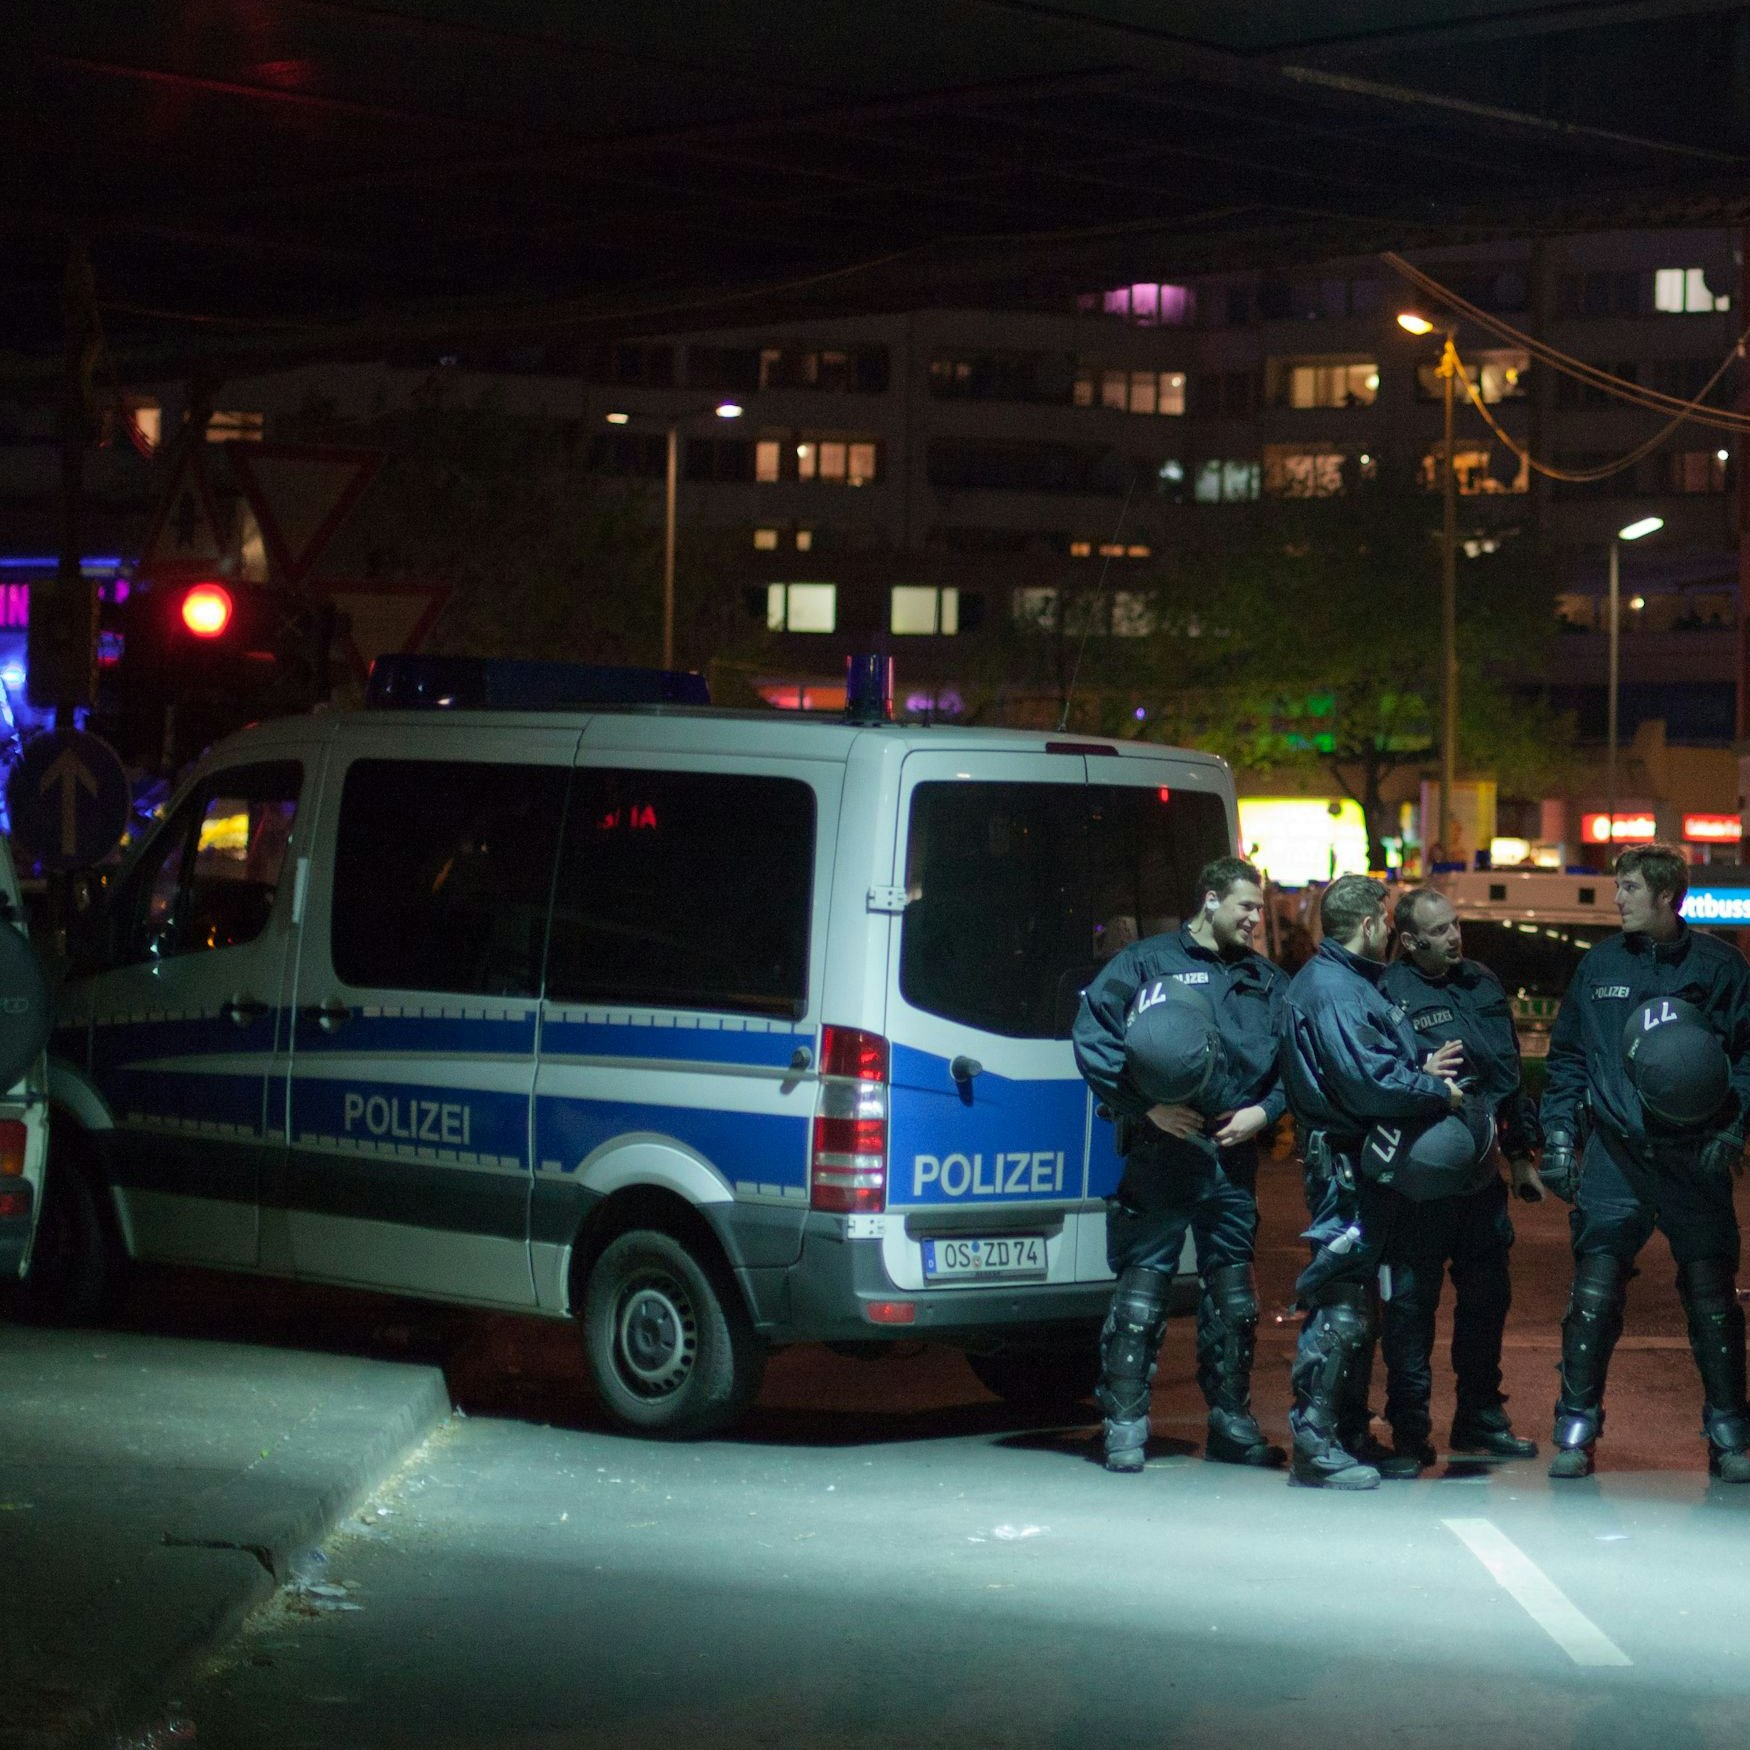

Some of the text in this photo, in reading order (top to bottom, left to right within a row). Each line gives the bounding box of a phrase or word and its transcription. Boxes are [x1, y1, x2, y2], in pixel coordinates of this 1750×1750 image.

[1412, 1008, 1453, 1031] POLIZEI
[344, 1092, 471, 1146] POLIZEI
[912, 1151, 1065, 1197] POLIZEI
[944, 1243, 971, 1269] OS
[983, 1242, 1010, 1267] ZD
[1013, 1241, 1038, 1265] 74
